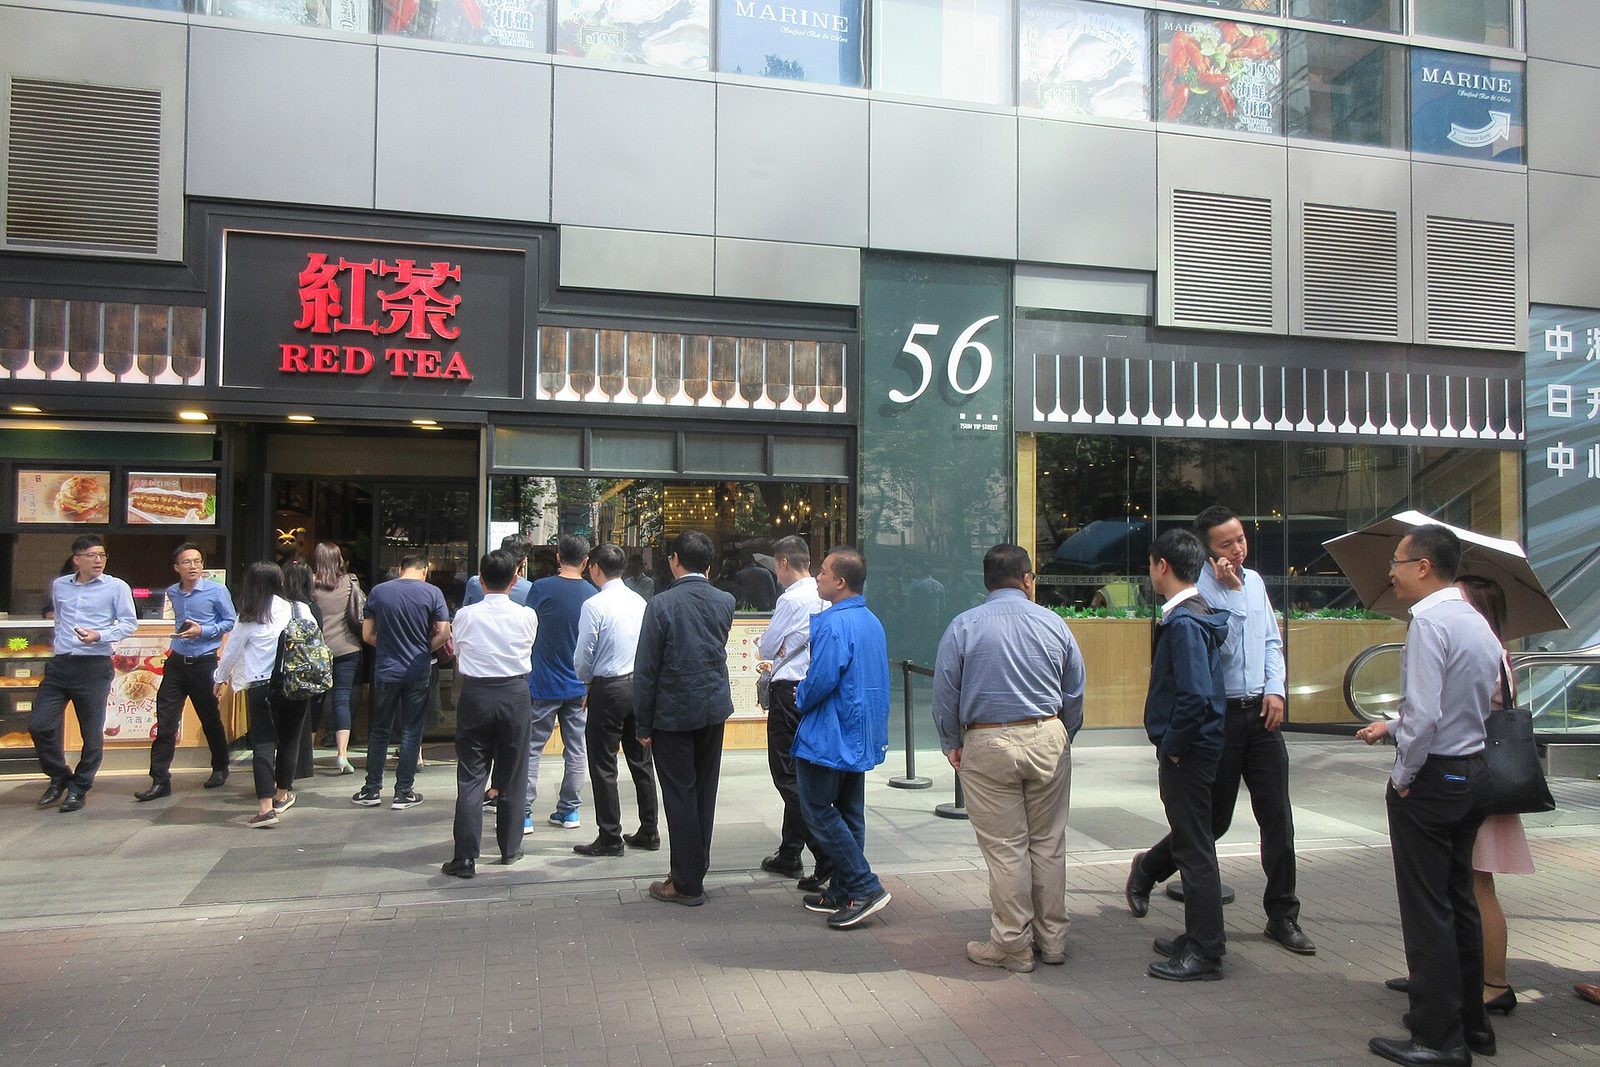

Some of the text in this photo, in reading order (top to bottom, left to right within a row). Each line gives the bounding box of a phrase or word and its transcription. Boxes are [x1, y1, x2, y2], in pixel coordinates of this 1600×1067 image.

[734, 0, 849, 33] MARINE
[1422, 67, 1511, 93] MARINE
[293, 252, 462, 340] 紅茶
[278, 343, 474, 381] RED TEA
[888, 315, 1000, 403] 56
